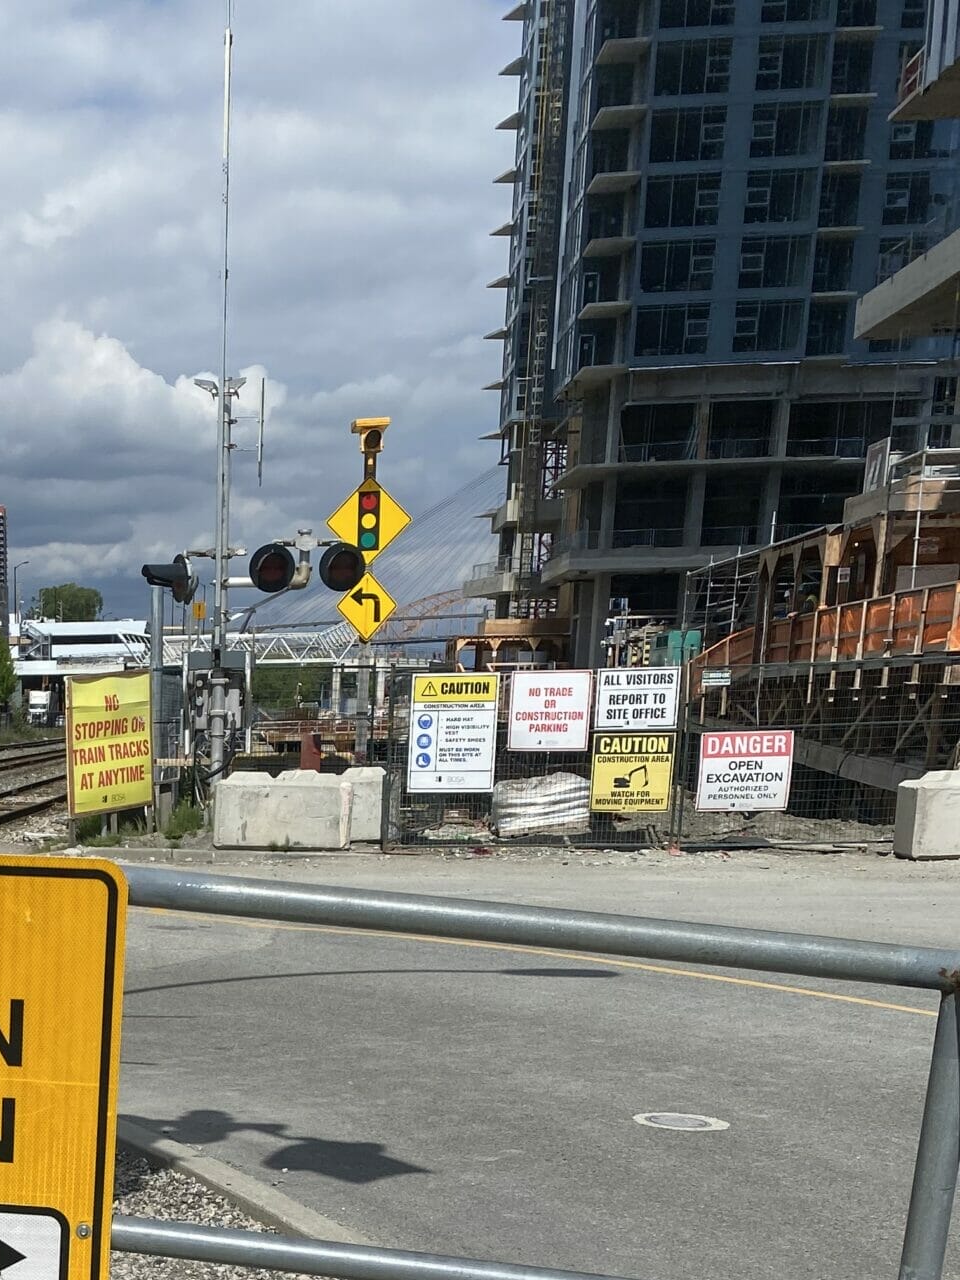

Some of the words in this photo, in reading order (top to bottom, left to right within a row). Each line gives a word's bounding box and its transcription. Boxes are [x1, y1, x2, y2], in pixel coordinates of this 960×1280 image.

[603, 674, 622, 686] ALL
[626, 673, 674, 686] VISITORS
[440, 682, 490, 695] CAUTION
[528, 688, 541, 697] NO
[544, 687, 574, 697] TRADE
[104, 694, 120, 712] NO
[544, 700, 556, 709] OR
[608, 693, 649, 706] REPORT
[653, 693, 666, 704] TO
[515, 711, 584, 721] CONSTRUCTION
[606, 708, 629, 720] SITE
[632, 707, 667, 719] OFFICE
[74, 717, 128, 741] STOPPING
[131, 716, 146, 733] ON
[528, 723, 568, 733] PARKING
[599, 736, 669, 754] CAUTION
[707, 734, 787, 755] DANGER
[73, 745, 106, 766] TRAIN
[108, 739, 150, 761] TRACKS
[597, 755, 650, 763] CONSTRUCTION
[651, 755, 670, 763] AREA
[728, 760, 763, 770] OPEN
[80, 772, 95, 791] AT
[98, 764, 145, 788] ANYTIME
[706, 772, 784, 783] EXCAVATION
